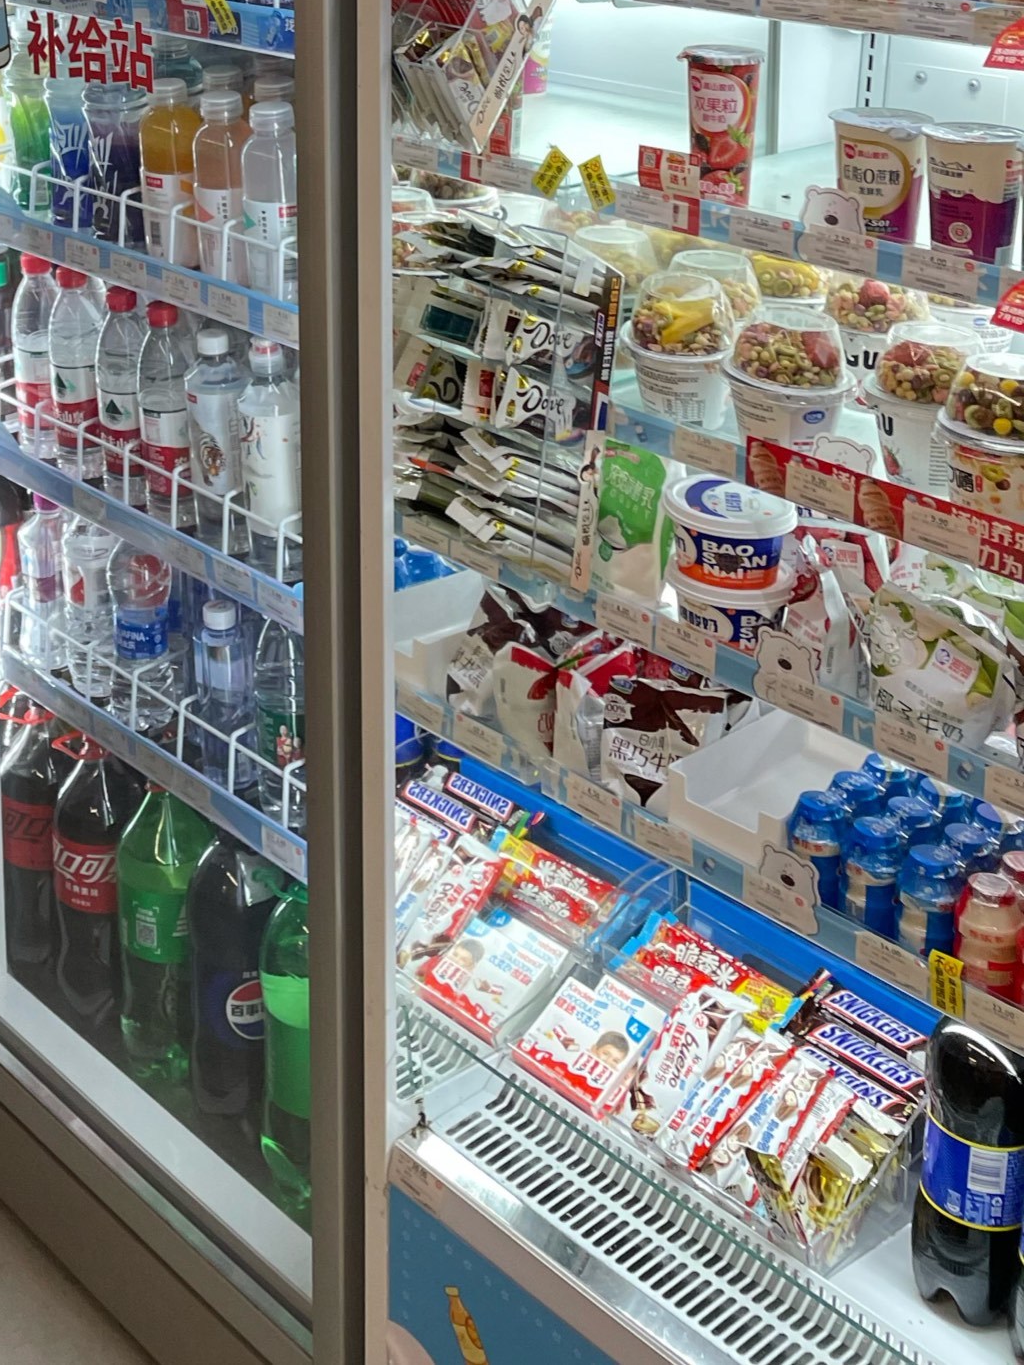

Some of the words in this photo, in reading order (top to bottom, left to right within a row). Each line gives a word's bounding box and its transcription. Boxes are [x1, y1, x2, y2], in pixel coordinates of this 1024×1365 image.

[27, 10, 154, 93] 补给站
[694, 95, 738, 114] 双果粒
[843, 163, 901, 186] 低脂0蔗糖
[858, 187, 884, 197] 发酵乳
[522, 322, 573, 350] Dove
[516, 385, 565, 415] Dove
[701, 538, 755, 557] BAO
[675, 942, 741, 989] 脆香米
[830, 991, 918, 1044] SNICKERS
[668, 1030, 700, 1088] bueno
[820, 1023, 921, 1085] SNICKERS
